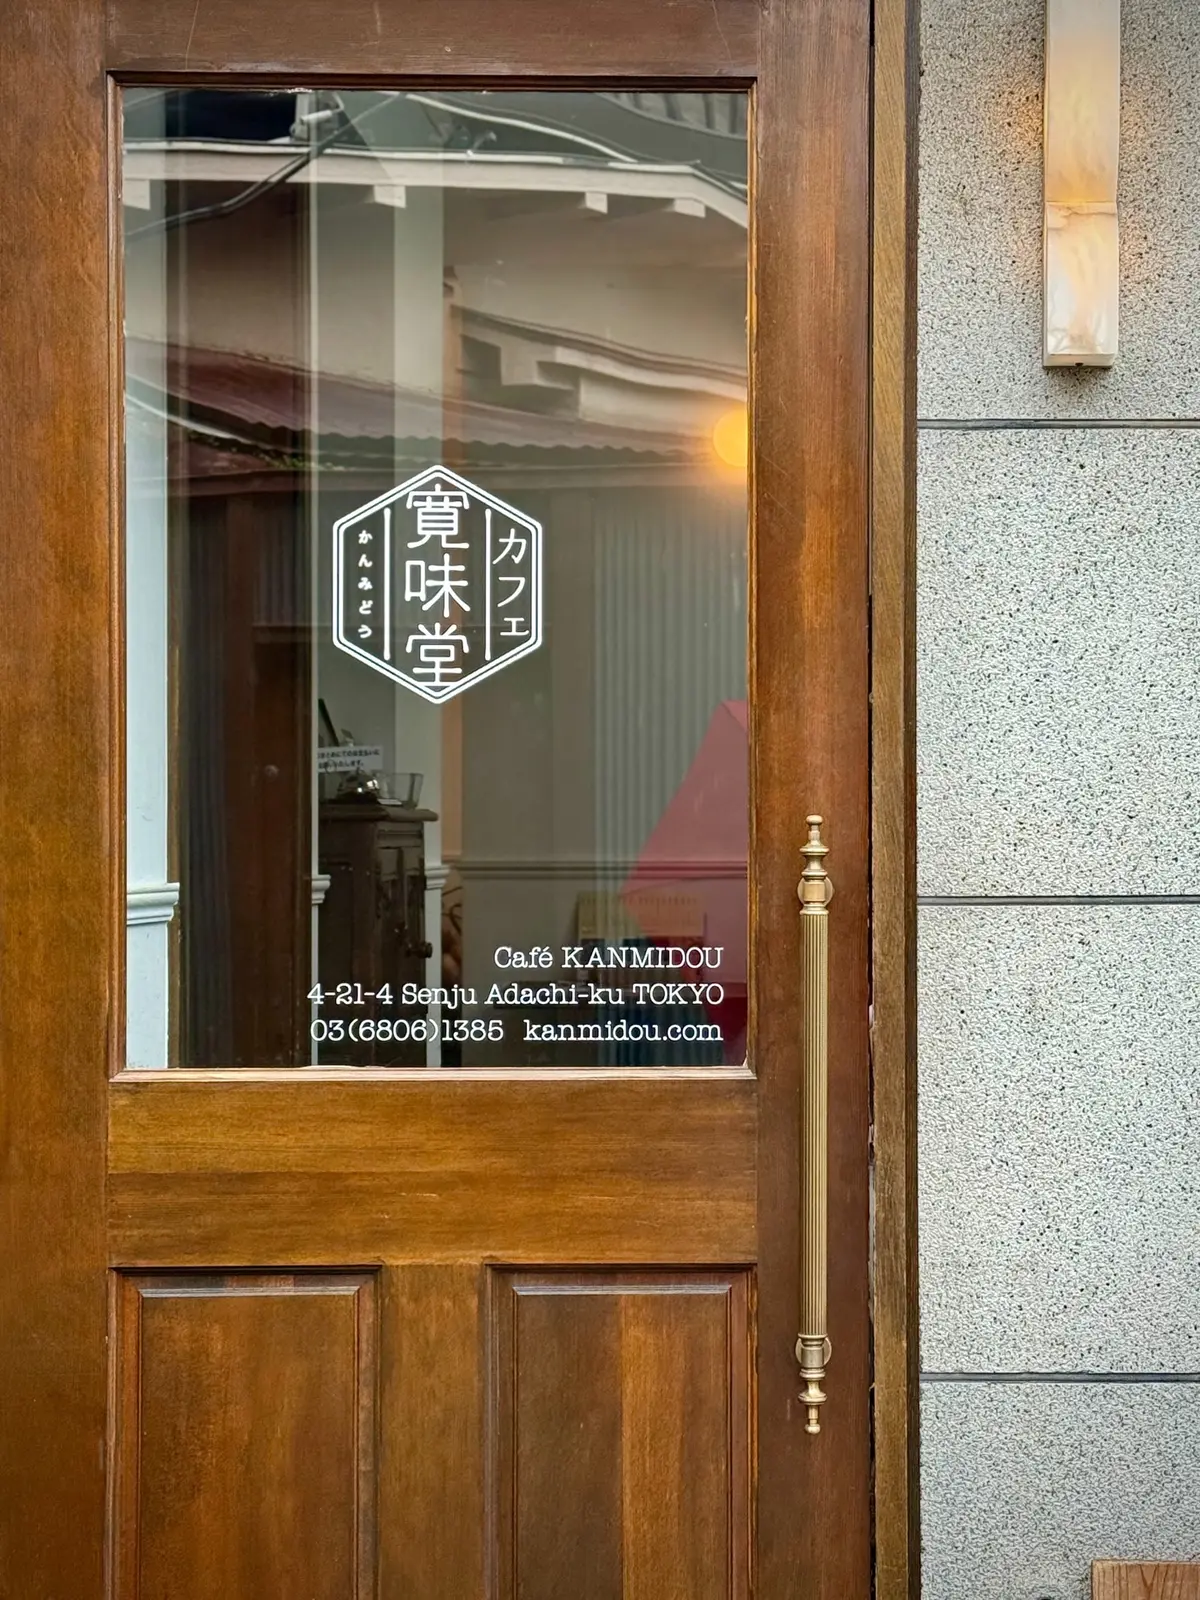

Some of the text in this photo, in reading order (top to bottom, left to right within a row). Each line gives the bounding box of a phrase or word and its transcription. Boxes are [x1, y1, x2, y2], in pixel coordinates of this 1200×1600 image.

[357, 529, 373, 639] かんみどう
[492, 527, 530, 636] カフェ
[494, 946, 723, 969] Café KANMIDOU
[306, 982, 724, 1010] 4-21-4 Senju Adachi-ku TOKYO
[309, 1018, 724, 1042] 03(6806)1385 kanmidou.com
